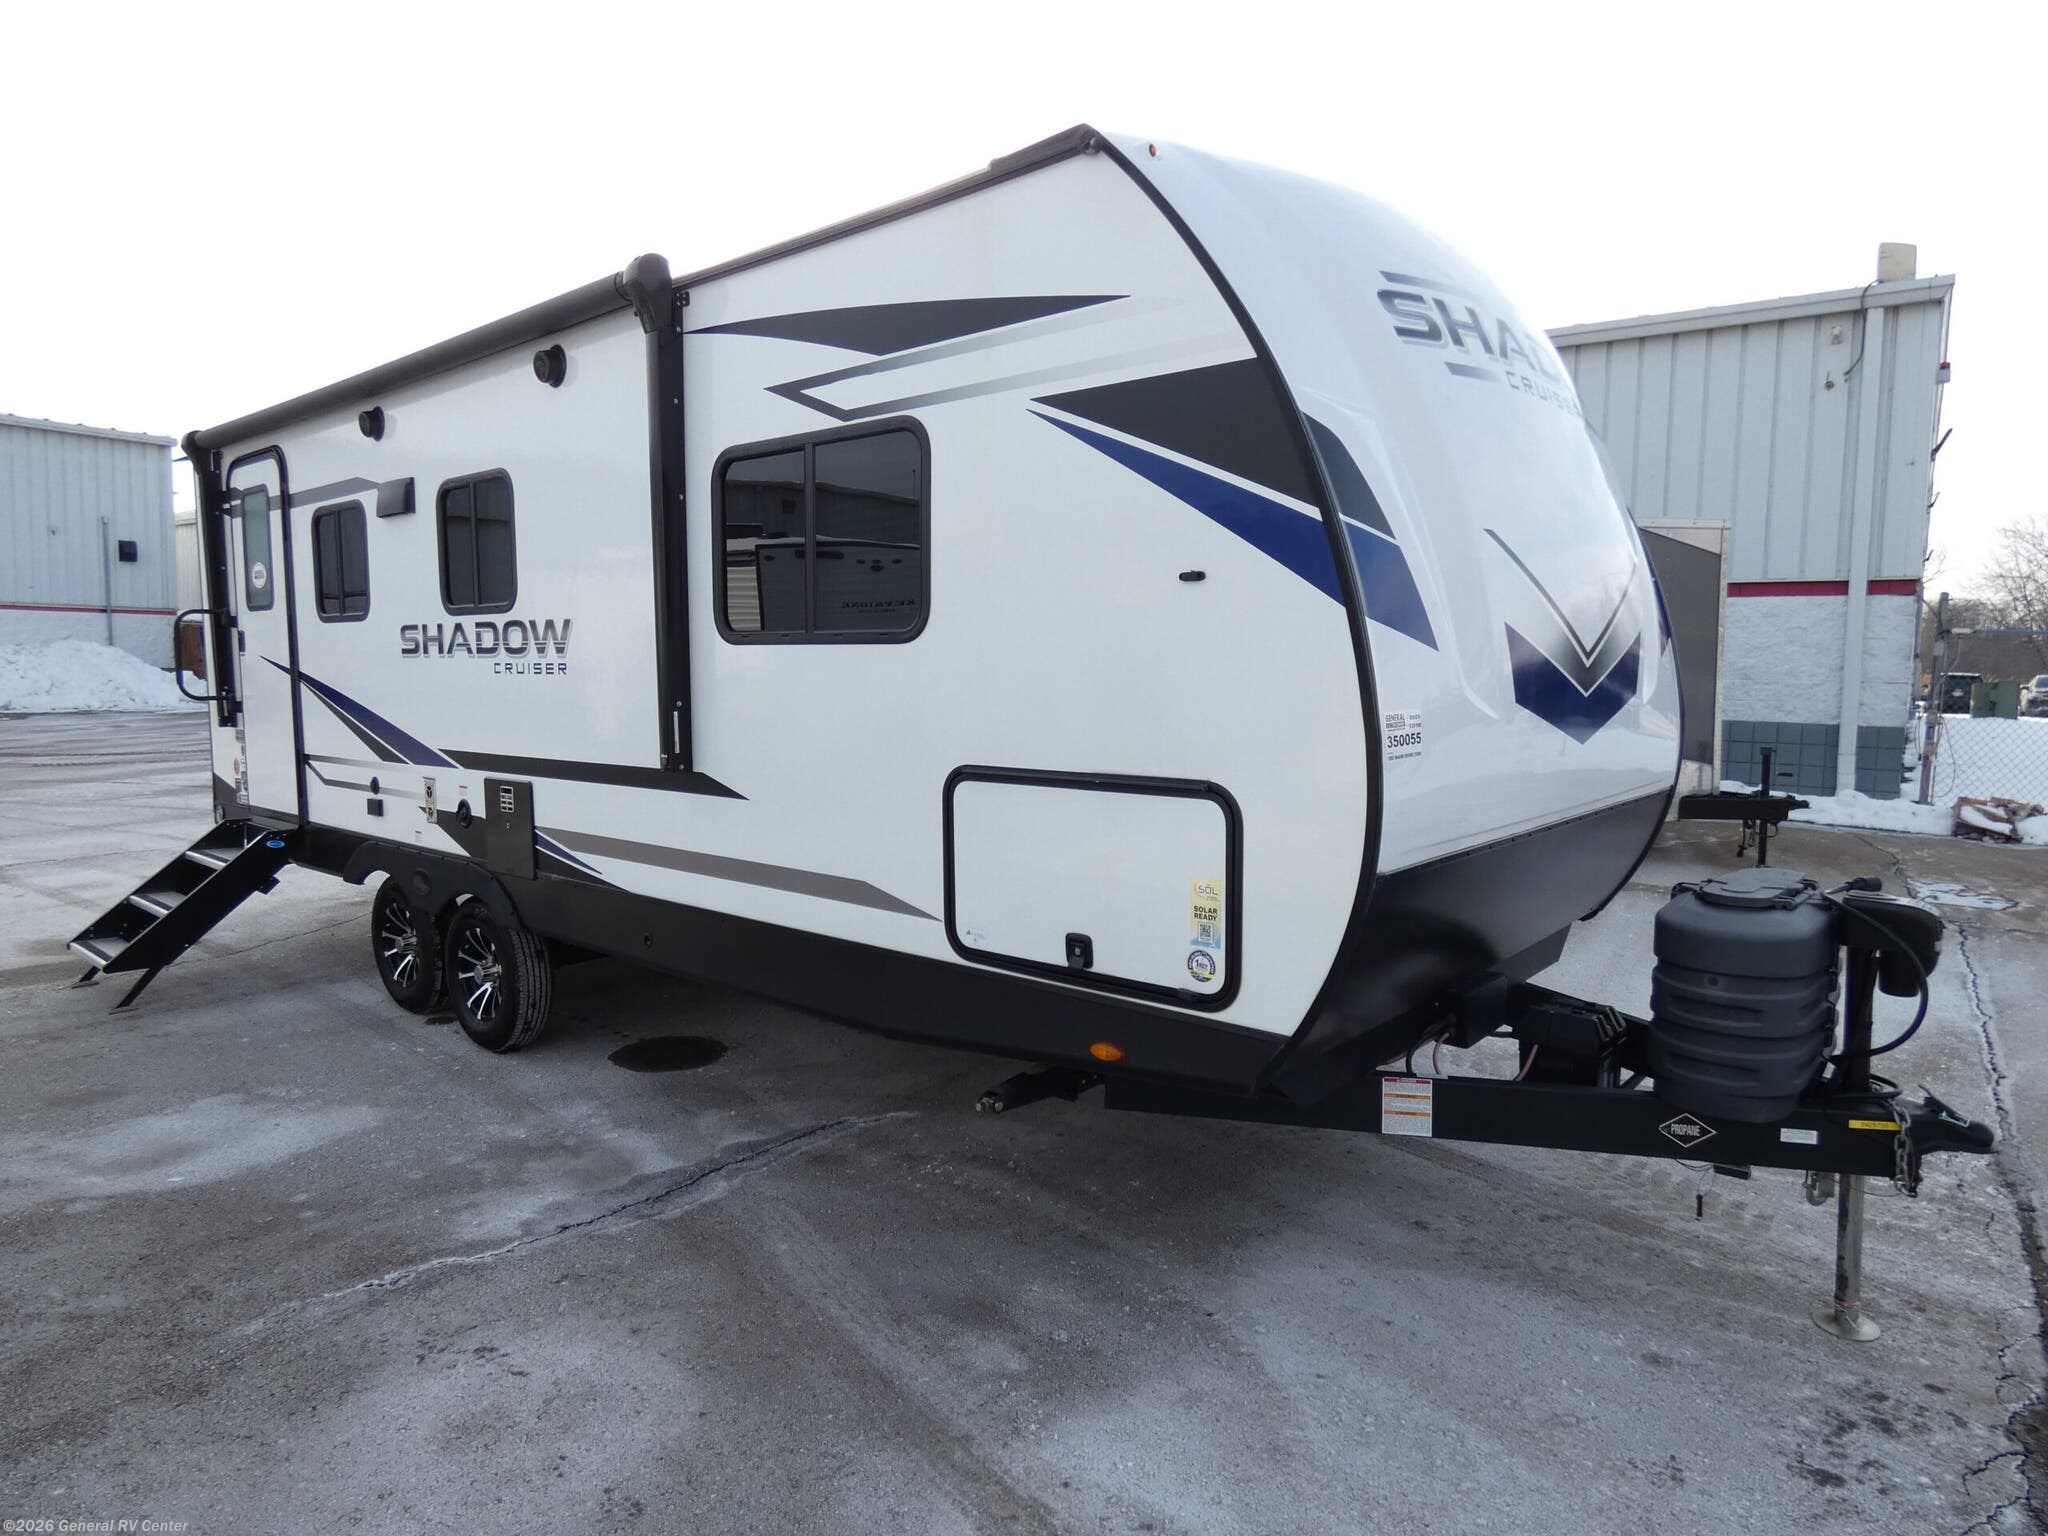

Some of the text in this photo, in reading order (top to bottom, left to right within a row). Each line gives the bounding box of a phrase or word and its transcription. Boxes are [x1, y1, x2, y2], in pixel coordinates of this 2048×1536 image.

[1377, 288, 1561, 384] SHAD
[400, 618, 572, 657] SHADOW
[494, 662, 568, 675] CRUISER
[1387, 732, 1421, 748] 350055
[1198, 885, 1218, 896] SOL
[1194, 905, 1218, 914] SOLAR
[1194, 912, 1218, 921] READY
[1670, 1123, 1700, 1136] PROPANE
